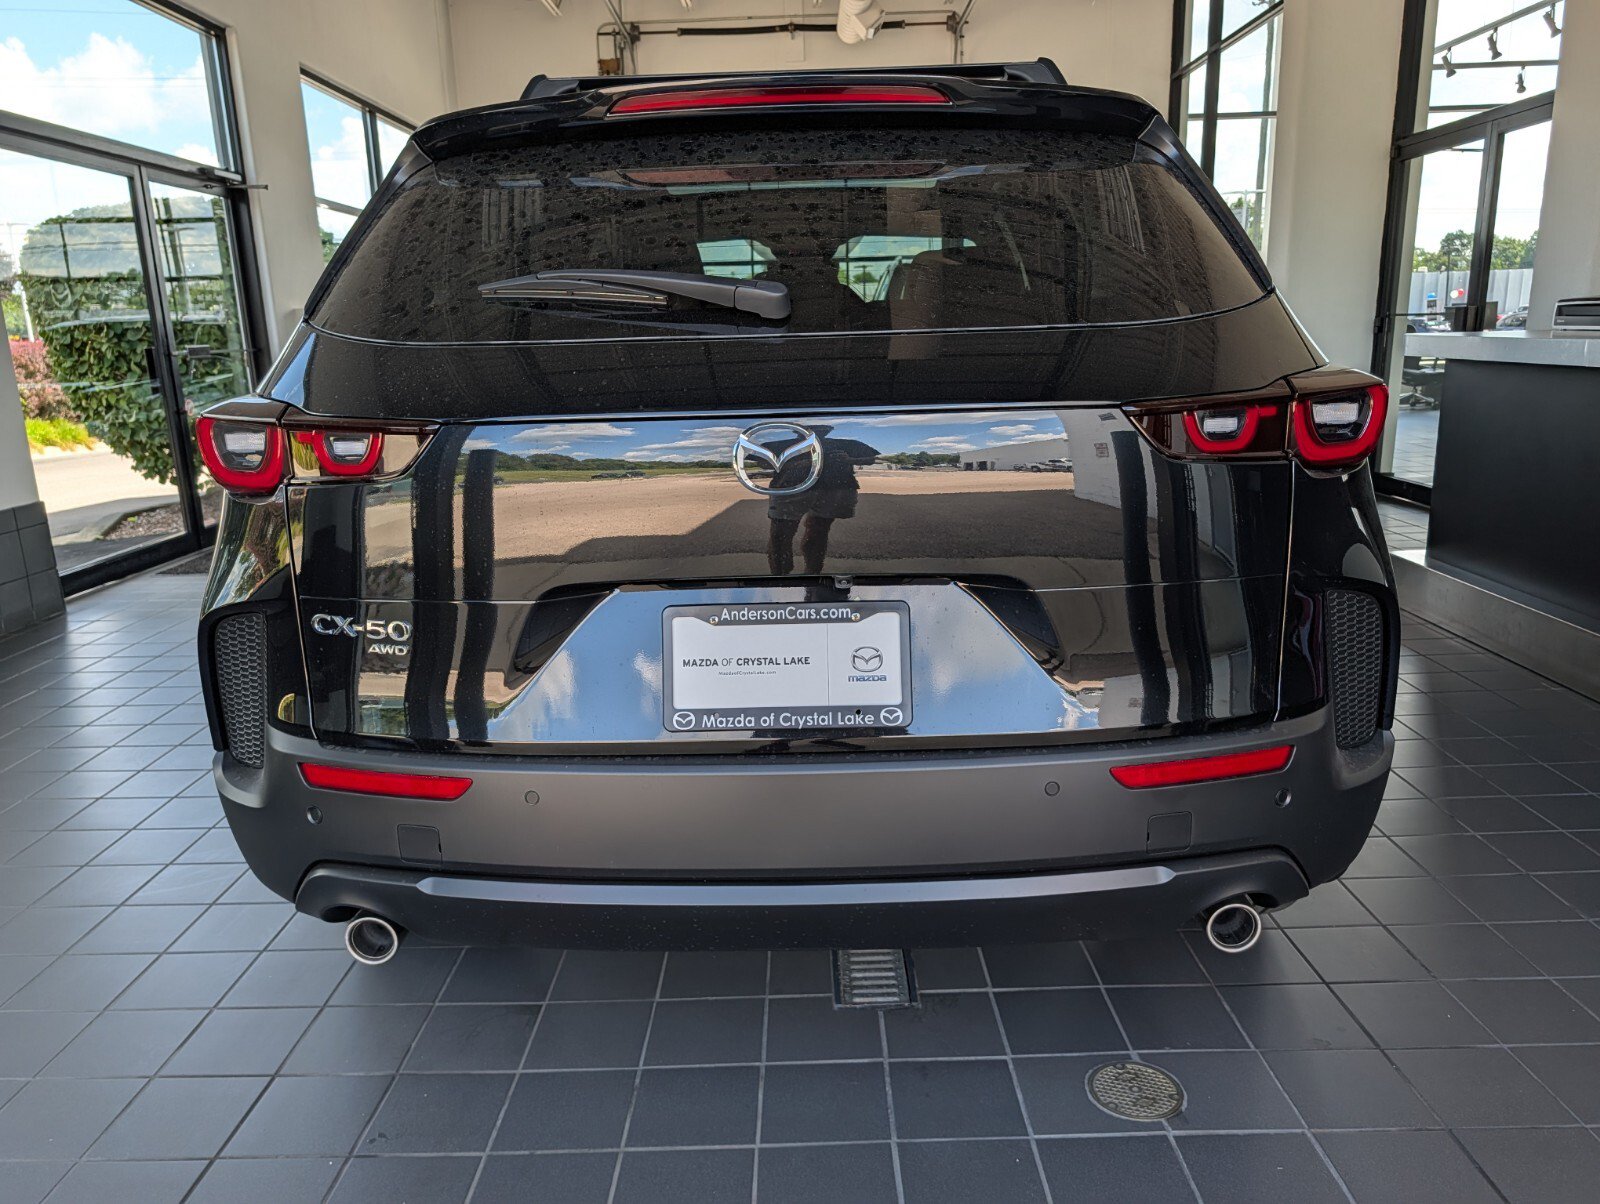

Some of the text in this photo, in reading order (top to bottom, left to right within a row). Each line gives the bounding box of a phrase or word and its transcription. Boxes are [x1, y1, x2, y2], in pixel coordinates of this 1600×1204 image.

[720, 606, 852, 622] AndersonCars.com
[310, 613, 413, 642] CX-50
[367, 643, 409, 656] AWD
[682, 656, 811, 668] MAZDA OF CRYSTAL LAKE
[701, 709, 875, 729] Mazda of Crystal Lake
